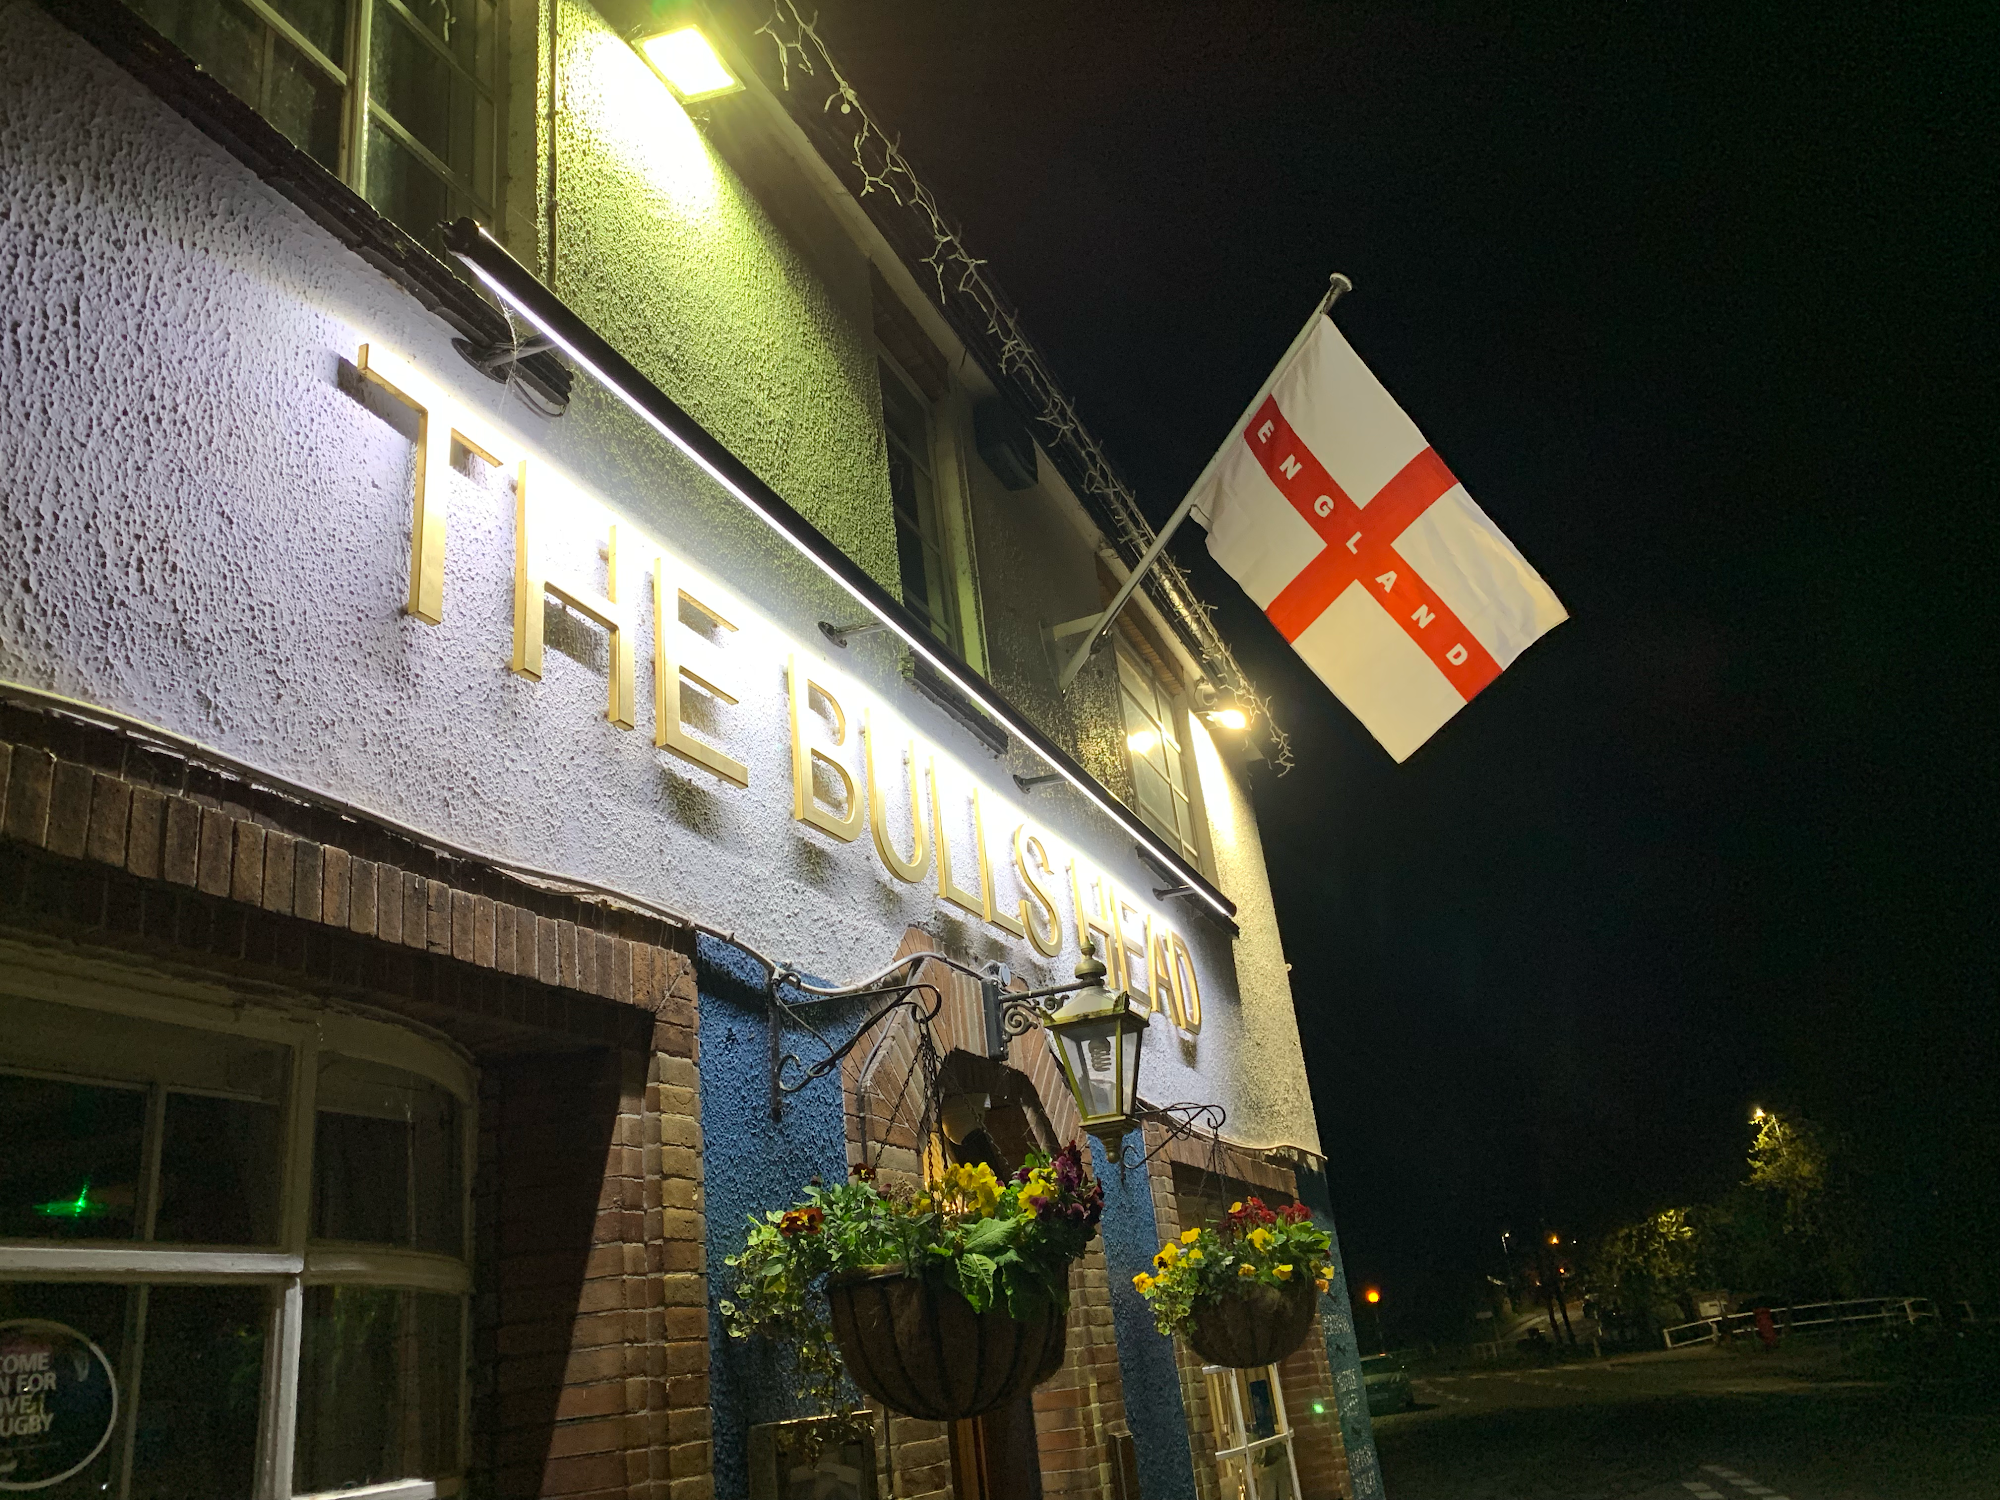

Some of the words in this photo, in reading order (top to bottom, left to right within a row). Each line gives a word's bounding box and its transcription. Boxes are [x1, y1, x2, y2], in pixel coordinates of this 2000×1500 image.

[1257, 419, 1468, 666] ENGLAND
[357, 342, 750, 789] THE
[788, 653, 1063, 957] BULLS
[1070, 858, 1201, 1036] HEAD
[0, 1353, 50, 1374] OME
[17, 1372, 57, 1394] FOR
[0, 1414, 54, 1438] UGBY
